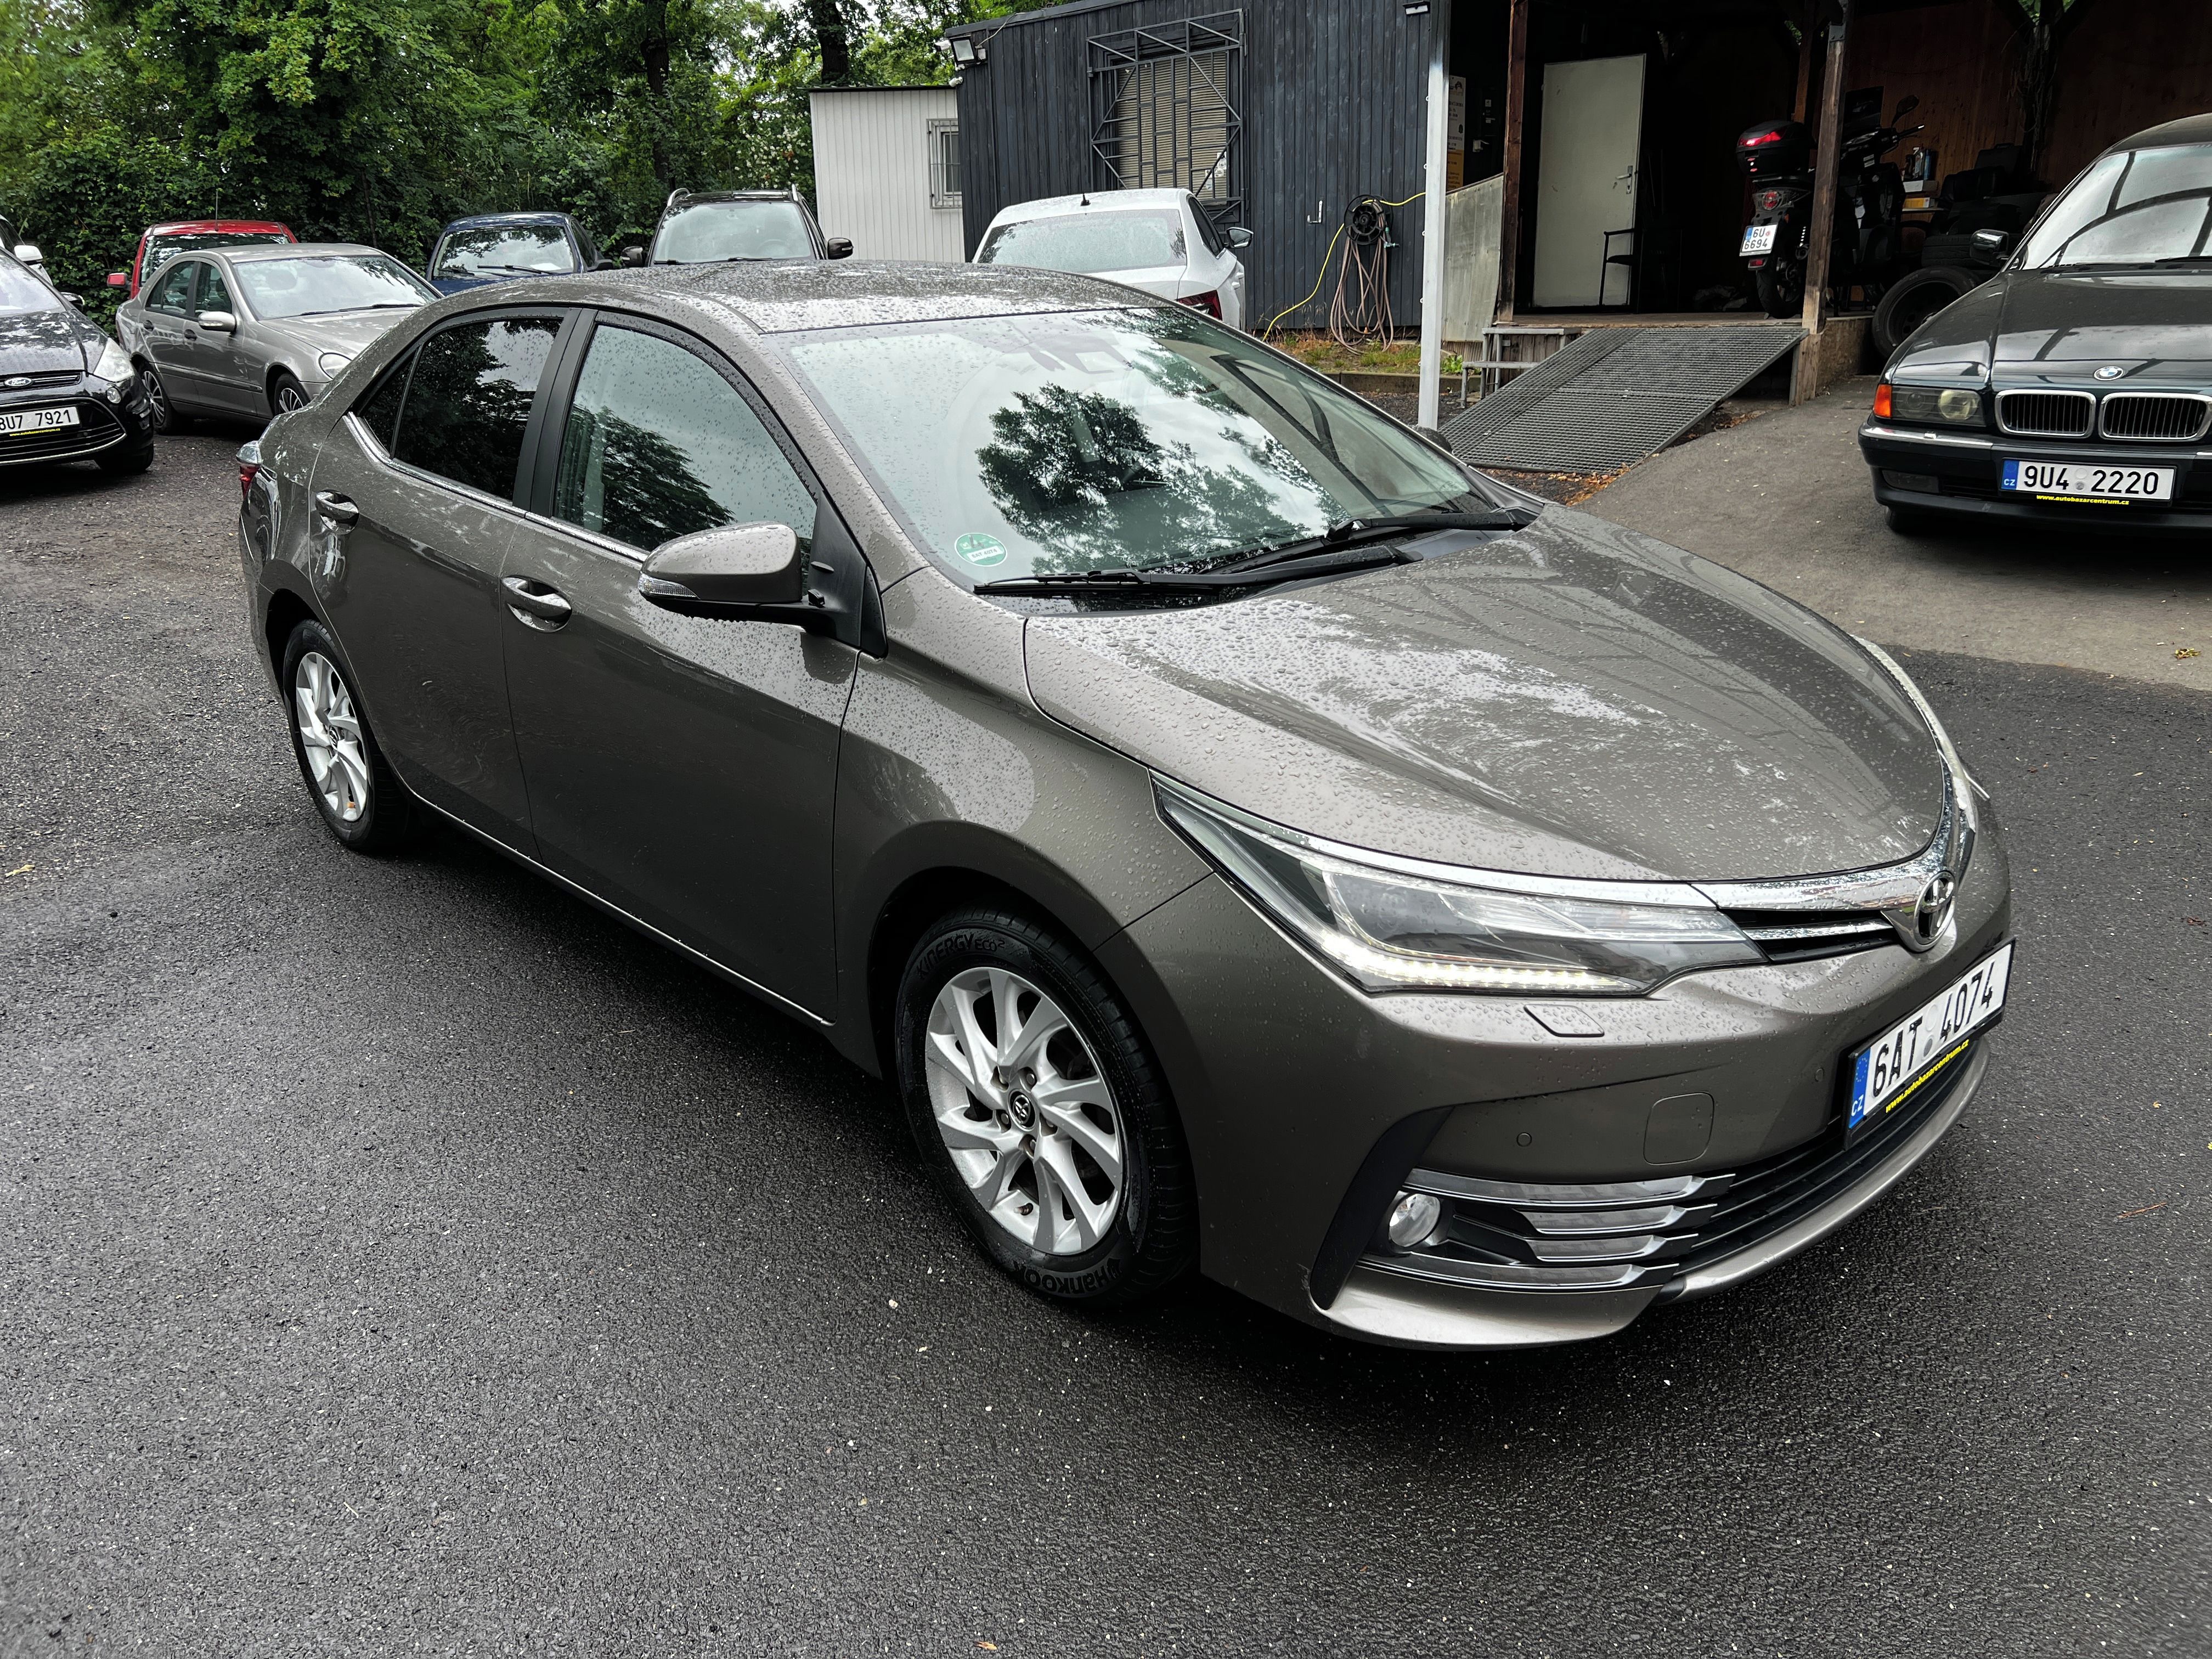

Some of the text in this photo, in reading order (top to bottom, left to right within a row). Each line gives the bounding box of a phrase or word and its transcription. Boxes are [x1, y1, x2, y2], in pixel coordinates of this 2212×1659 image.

[1753, 228, 1766, 238] 6U
[1744, 238, 1768, 250] 6694
[35, 409, 71, 427] 7921
[2004, 478, 2016, 486] CZ
[2023, 465, 2159, 495] 9U4 2220
[2036, 495, 2130, 505] www.autobazarcentrum.cz
[1872, 961, 1994, 1097] 6AT 4074
[1886, 1039, 1970, 1114] www.autobazarcentrum.cz
[1851, 1095, 1864, 1116] CZ
